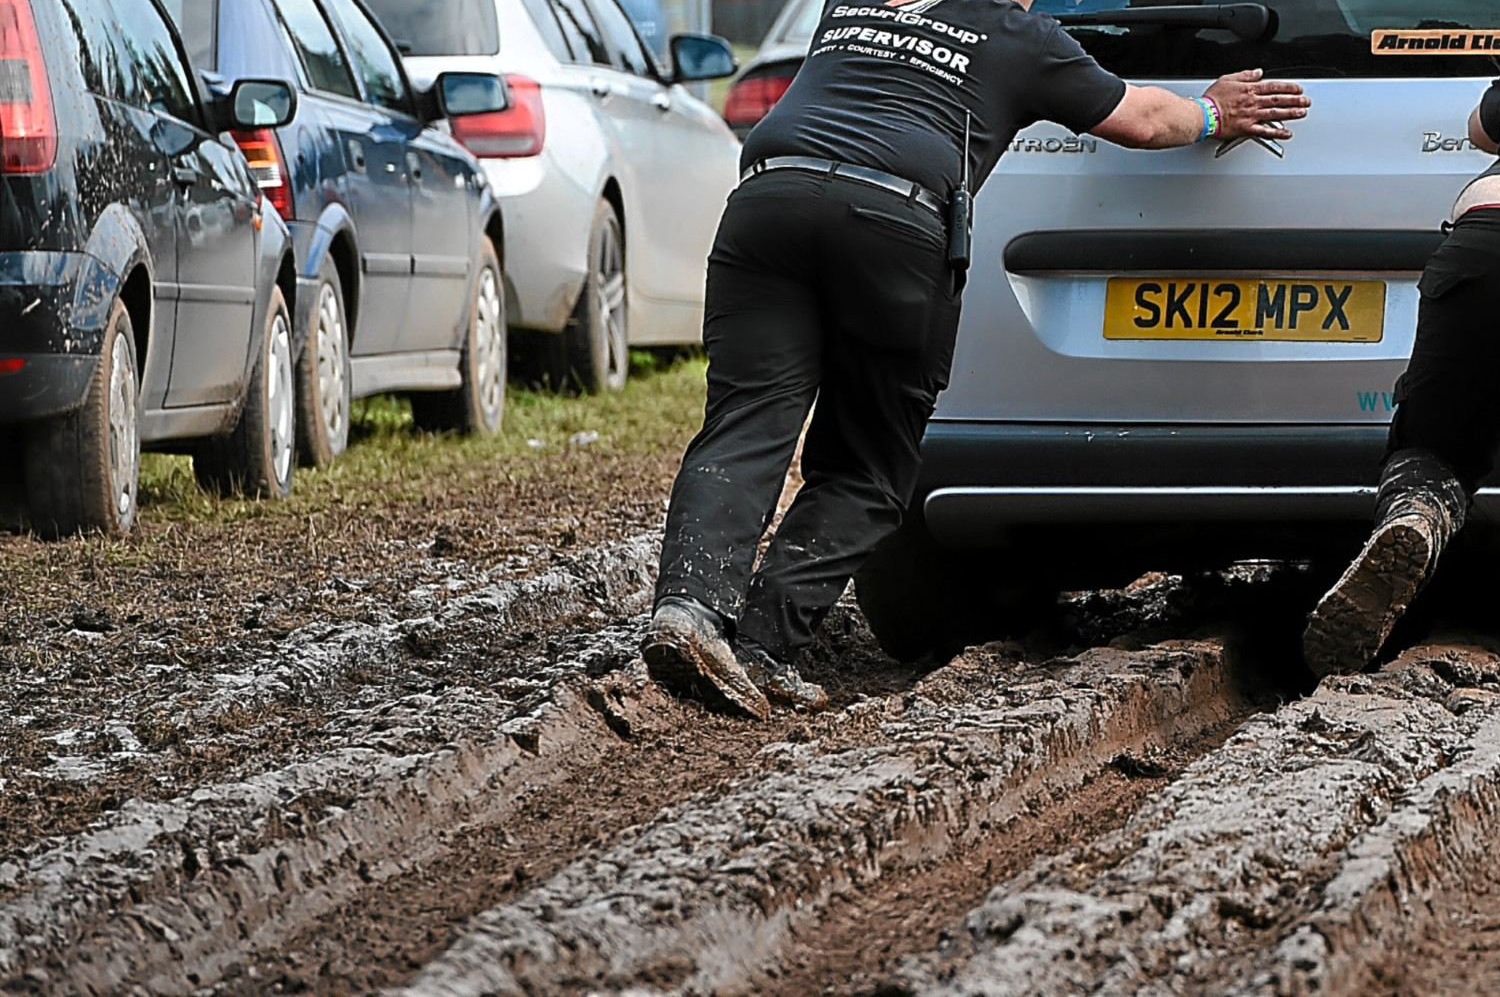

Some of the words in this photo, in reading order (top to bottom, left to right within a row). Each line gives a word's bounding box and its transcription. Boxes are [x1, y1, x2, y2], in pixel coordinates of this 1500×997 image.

[820, 26, 970, 74] SUPERVISOR
[1377, 34, 1467, 50] Arnold
[847, 43, 897, 60] COURTESY
[909, 57, 964, 86] EFFICIENCY
[1006, 136, 1097, 153] TROËN
[1133, 282, 1241, 329] SK12
[1254, 283, 1353, 331] MPX
